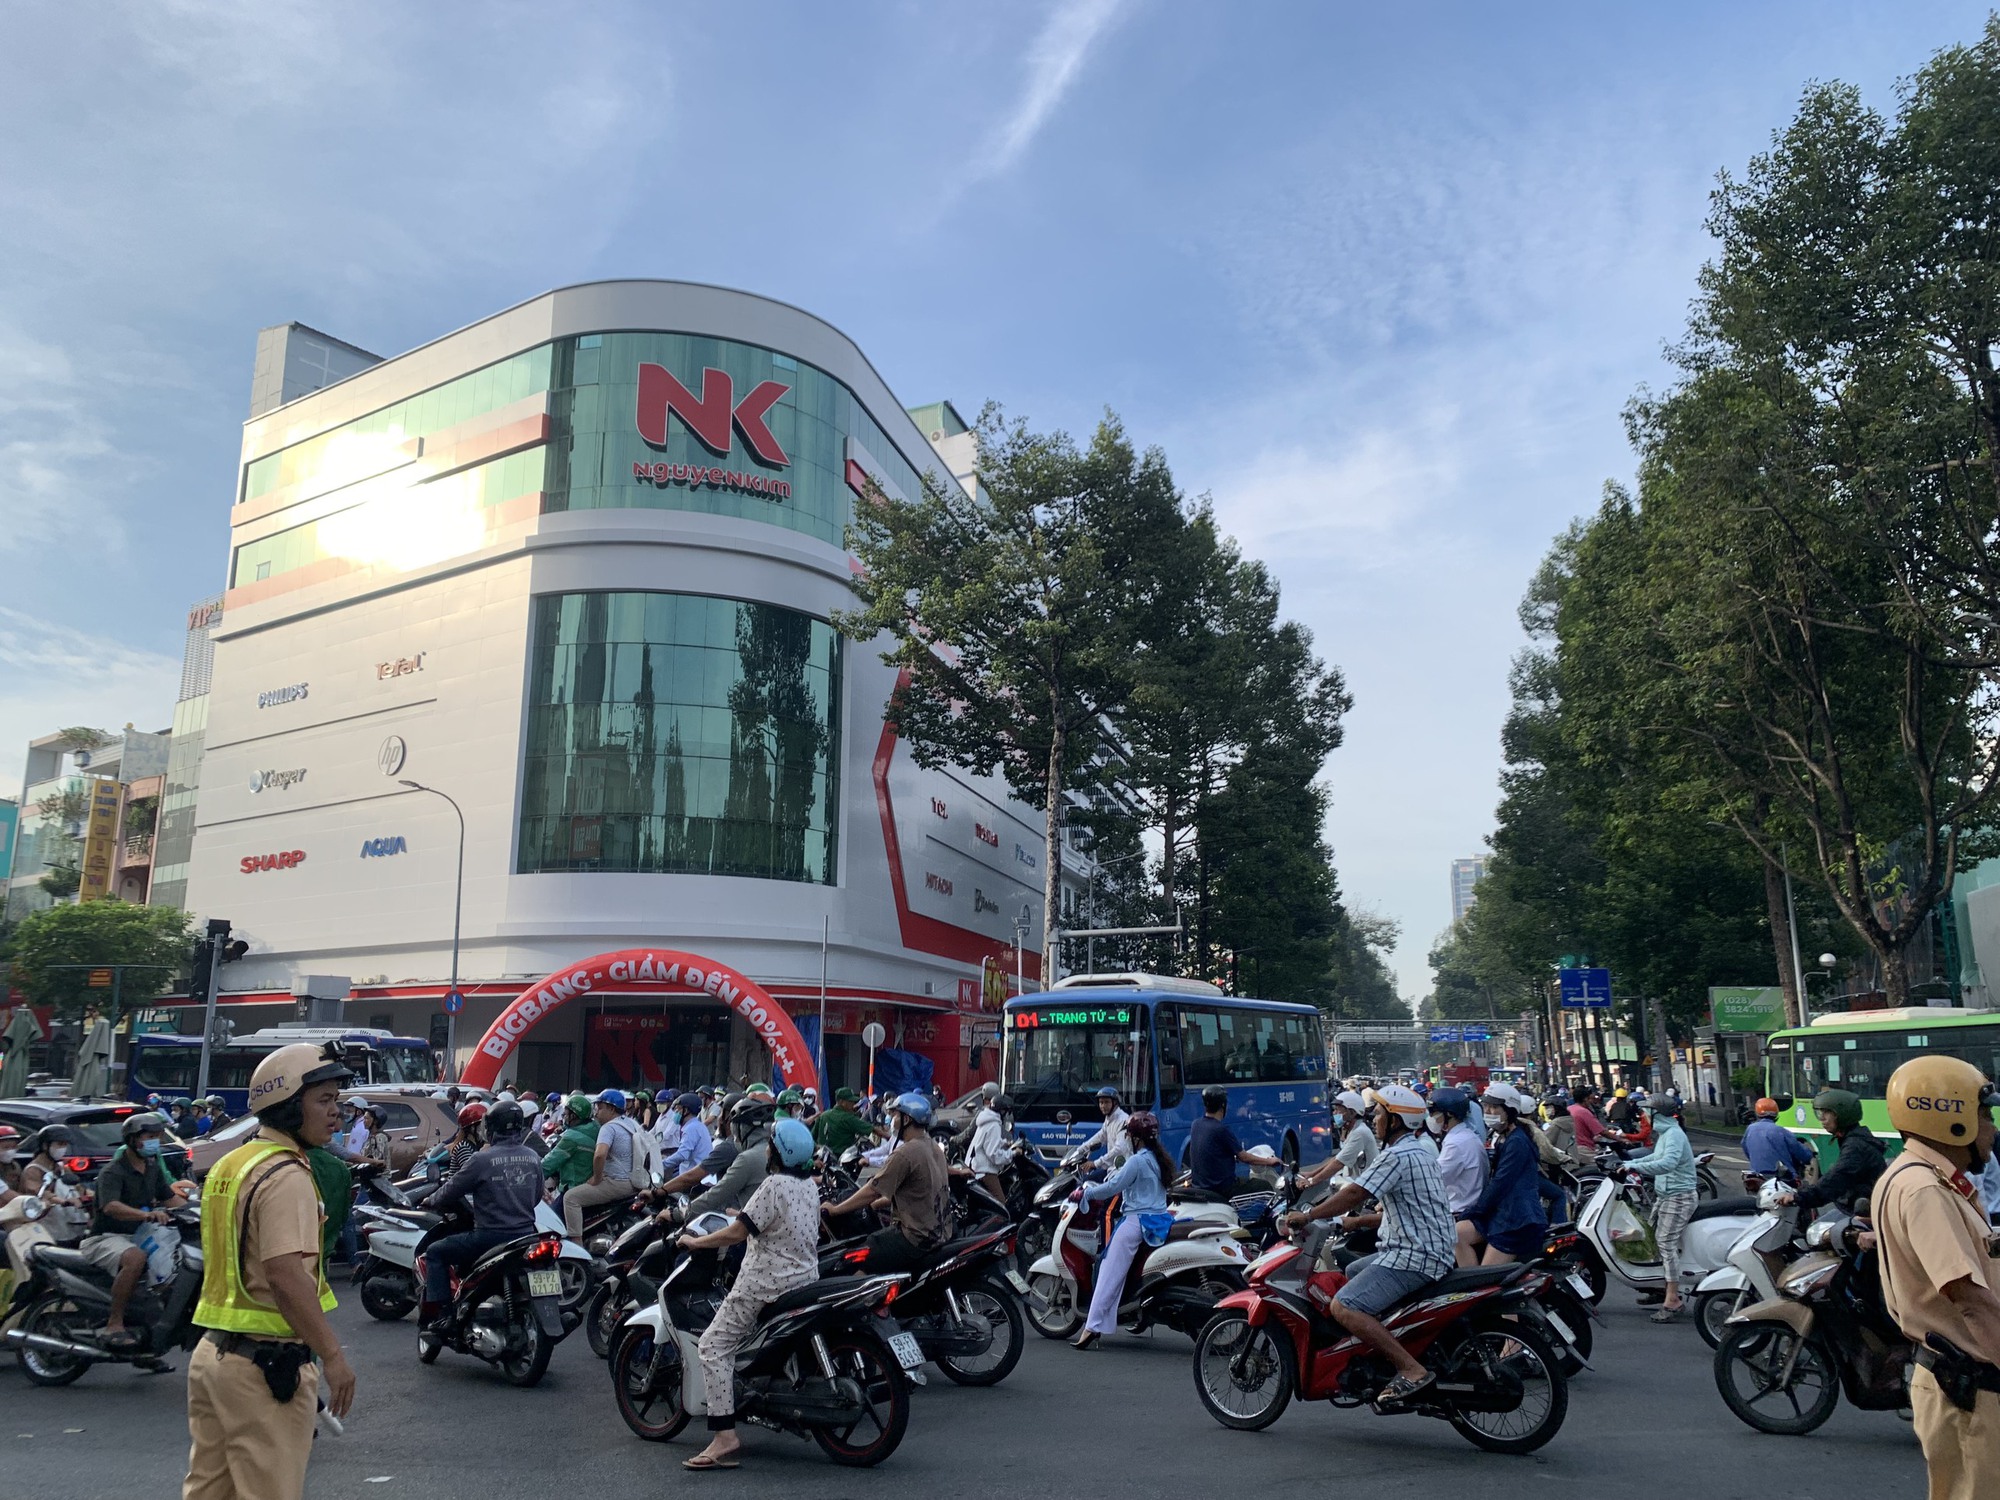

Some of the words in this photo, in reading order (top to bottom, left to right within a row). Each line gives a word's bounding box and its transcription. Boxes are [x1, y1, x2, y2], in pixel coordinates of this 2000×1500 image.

[636, 362, 792, 467] NK
[375, 653, 424, 681] Tefal
[257, 682, 308, 709] PHILIPS
[379, 736, 404, 776] hp
[360, 836, 407, 859] AQUA
[240, 850, 306, 874] SHARP
[482, 970, 592, 1059] BIGBANG
[608, 953, 680, 983] GIẢM
[684, 971, 740, 1004] ĐẾN
[1723, 996, 1751, 1005] (028)
[1016, 1012, 1038, 1028] 01
[1049, 1012, 1087, 1024] TRANG
[250, 1076, 285, 1101] CSGT
[1906, 1096, 1965, 1114] CSGT
